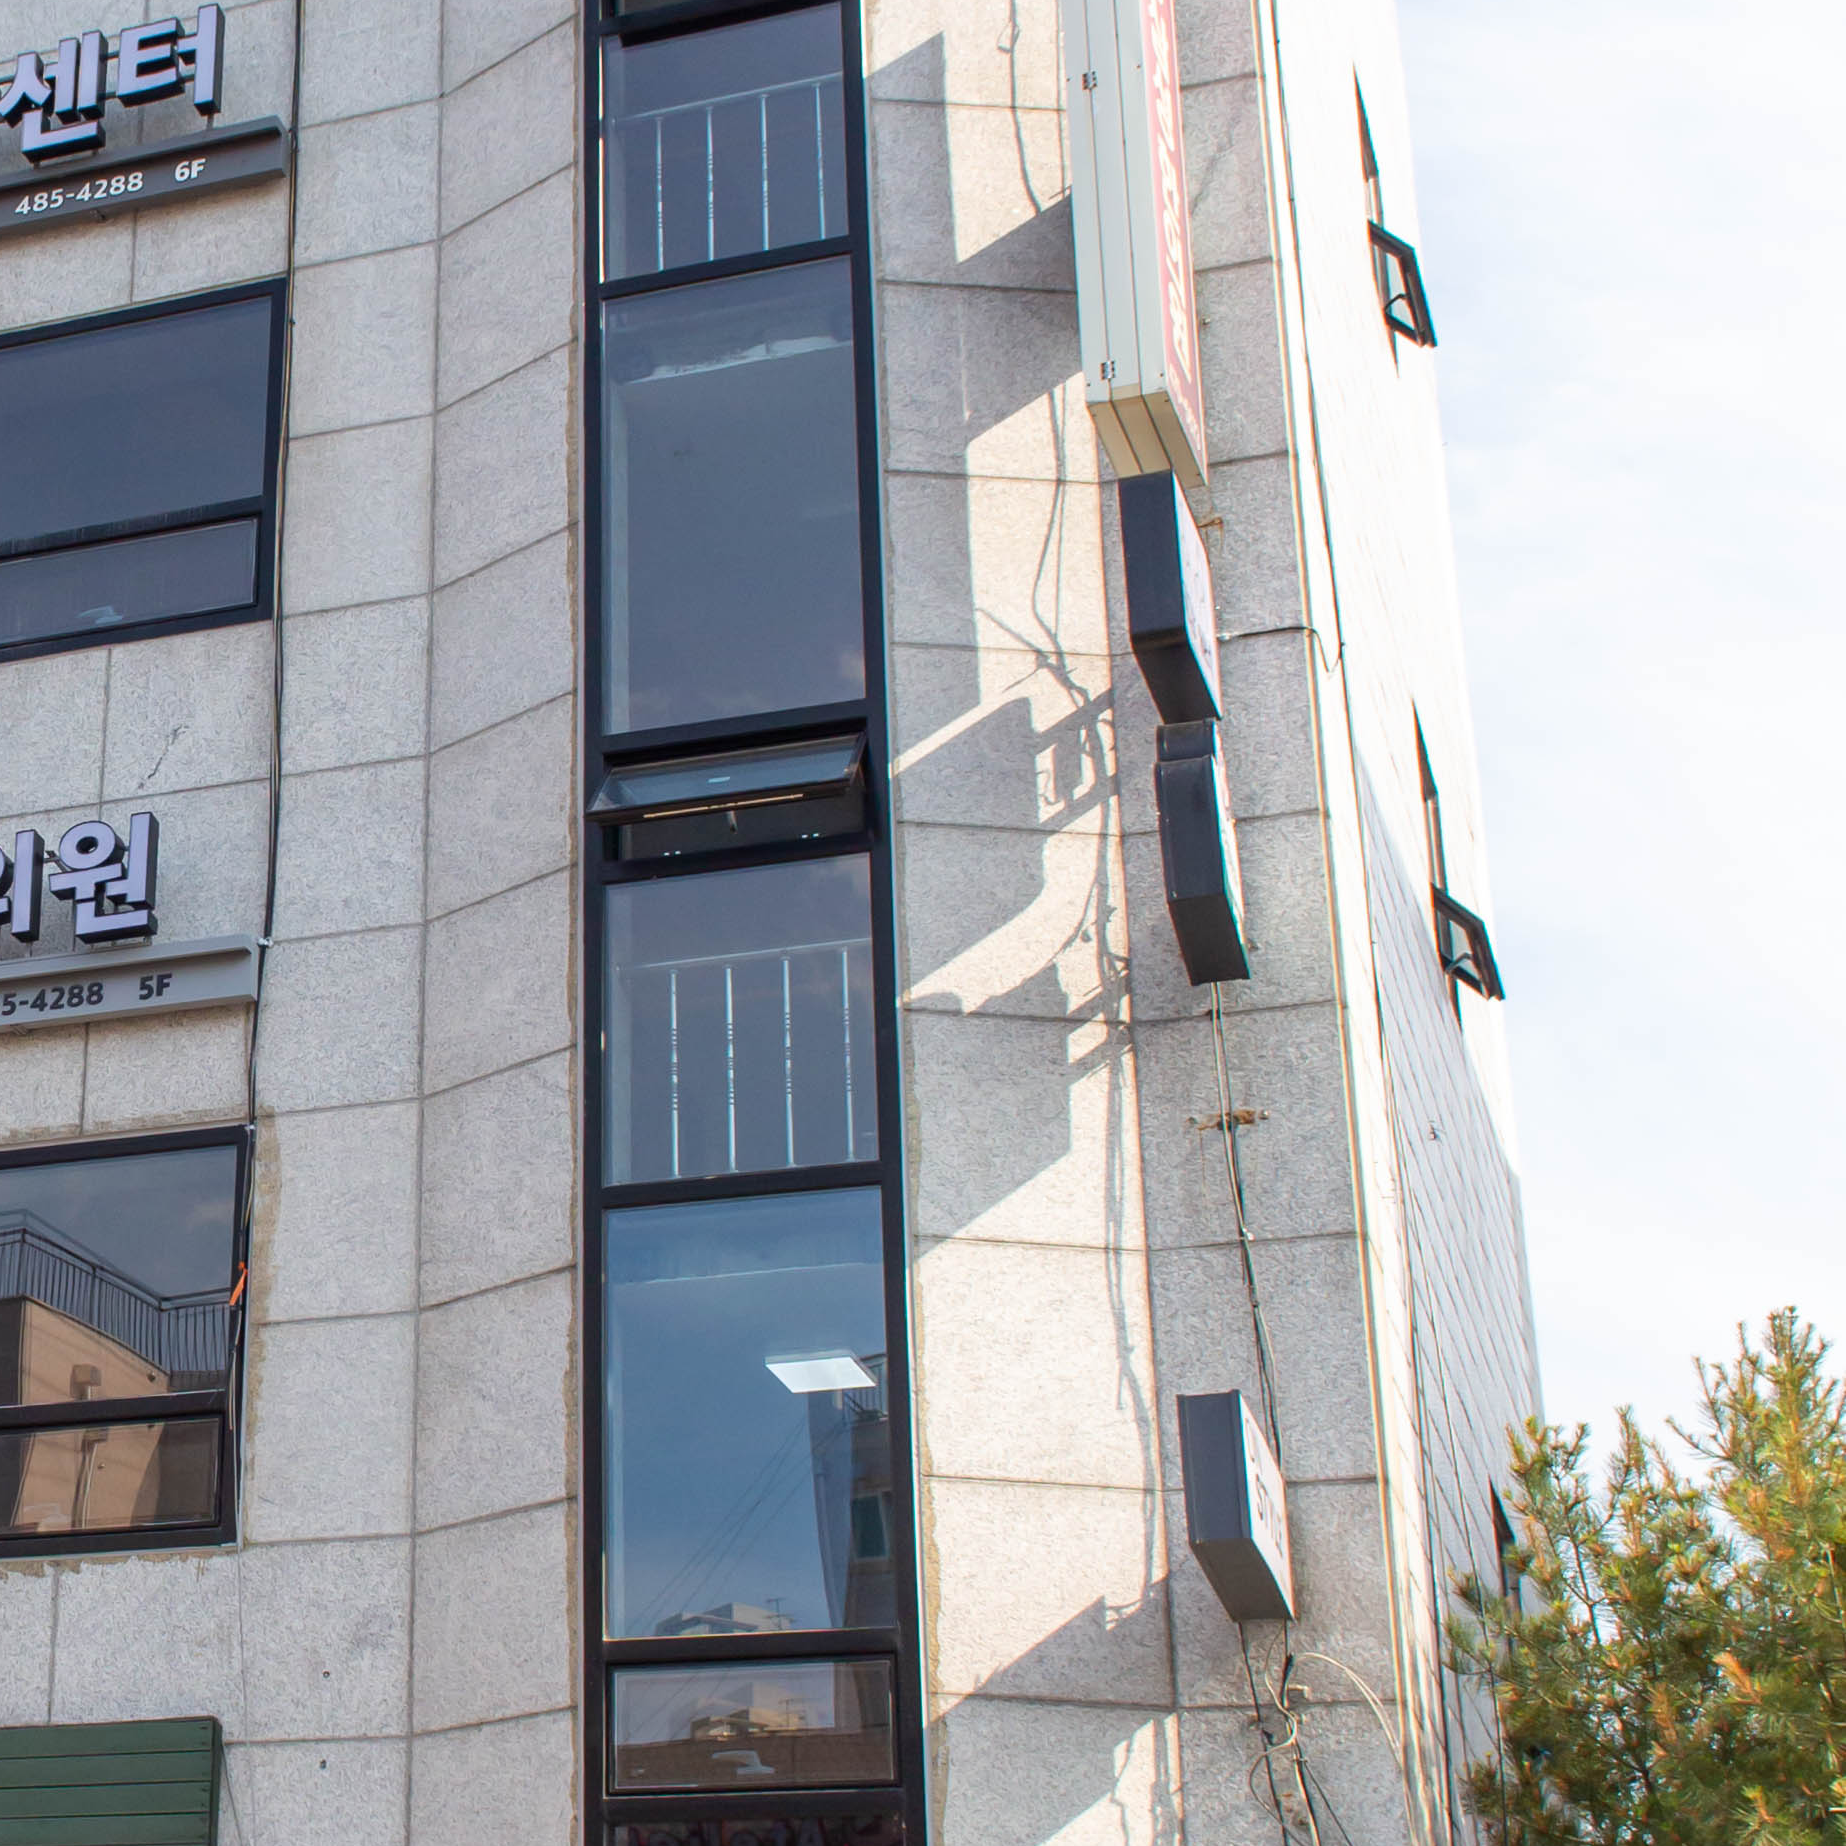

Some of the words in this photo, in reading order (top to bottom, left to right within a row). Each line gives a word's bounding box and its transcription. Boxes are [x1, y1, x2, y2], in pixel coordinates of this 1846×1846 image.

[15, 172, 144, 215] 485-4288
[174, 158, 207, 182] 6F
[139, 973, 173, 1000] 5F
